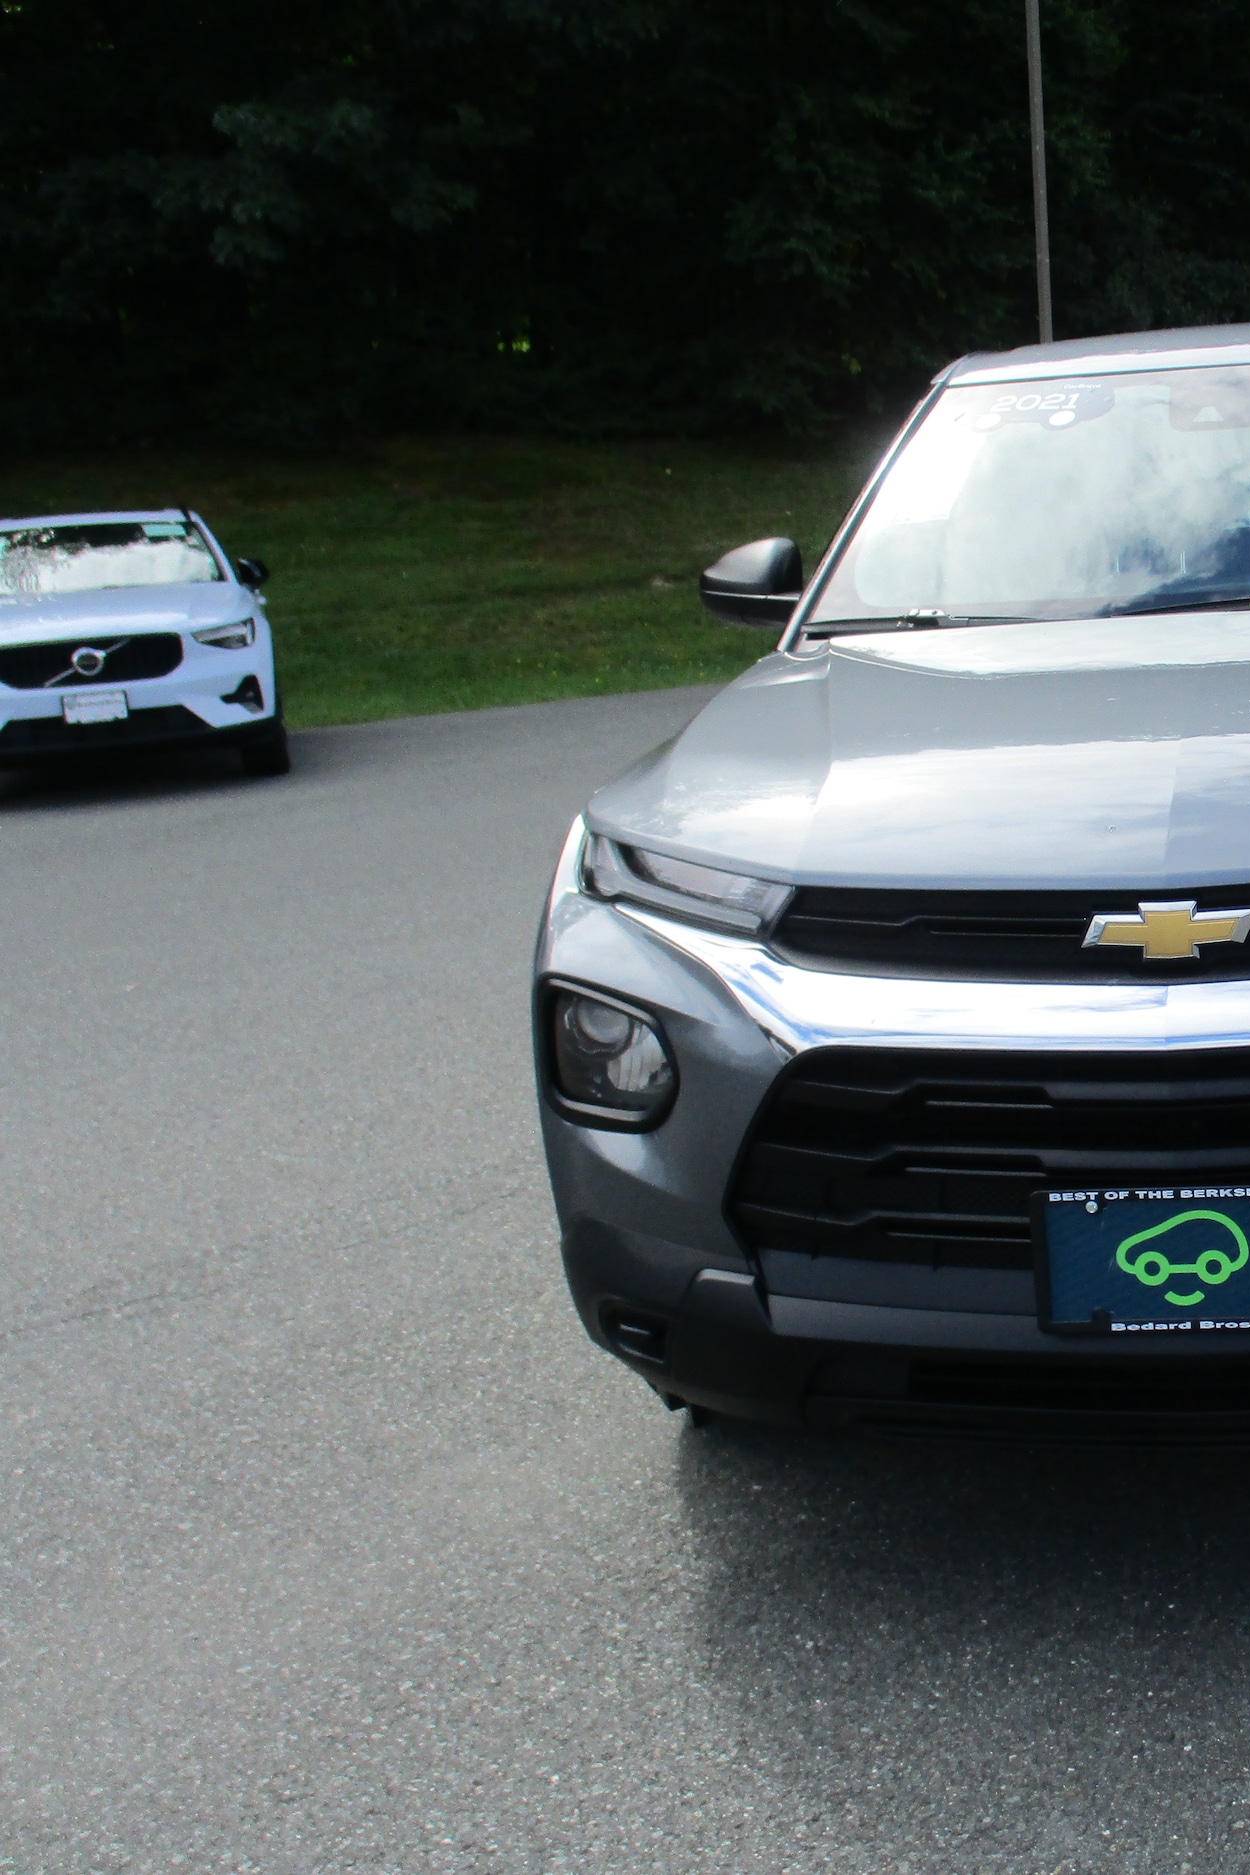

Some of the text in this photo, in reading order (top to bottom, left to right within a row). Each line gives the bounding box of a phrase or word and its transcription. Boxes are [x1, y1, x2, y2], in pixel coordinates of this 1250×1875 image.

[989, 392, 1080, 413] 2021
[1048, 1191, 1099, 1202] BEST
[1104, 1190, 1130, 1200] OF
[1135, 1189, 1174, 1200] THE
[1110, 1321, 1192, 1332] Bedard
